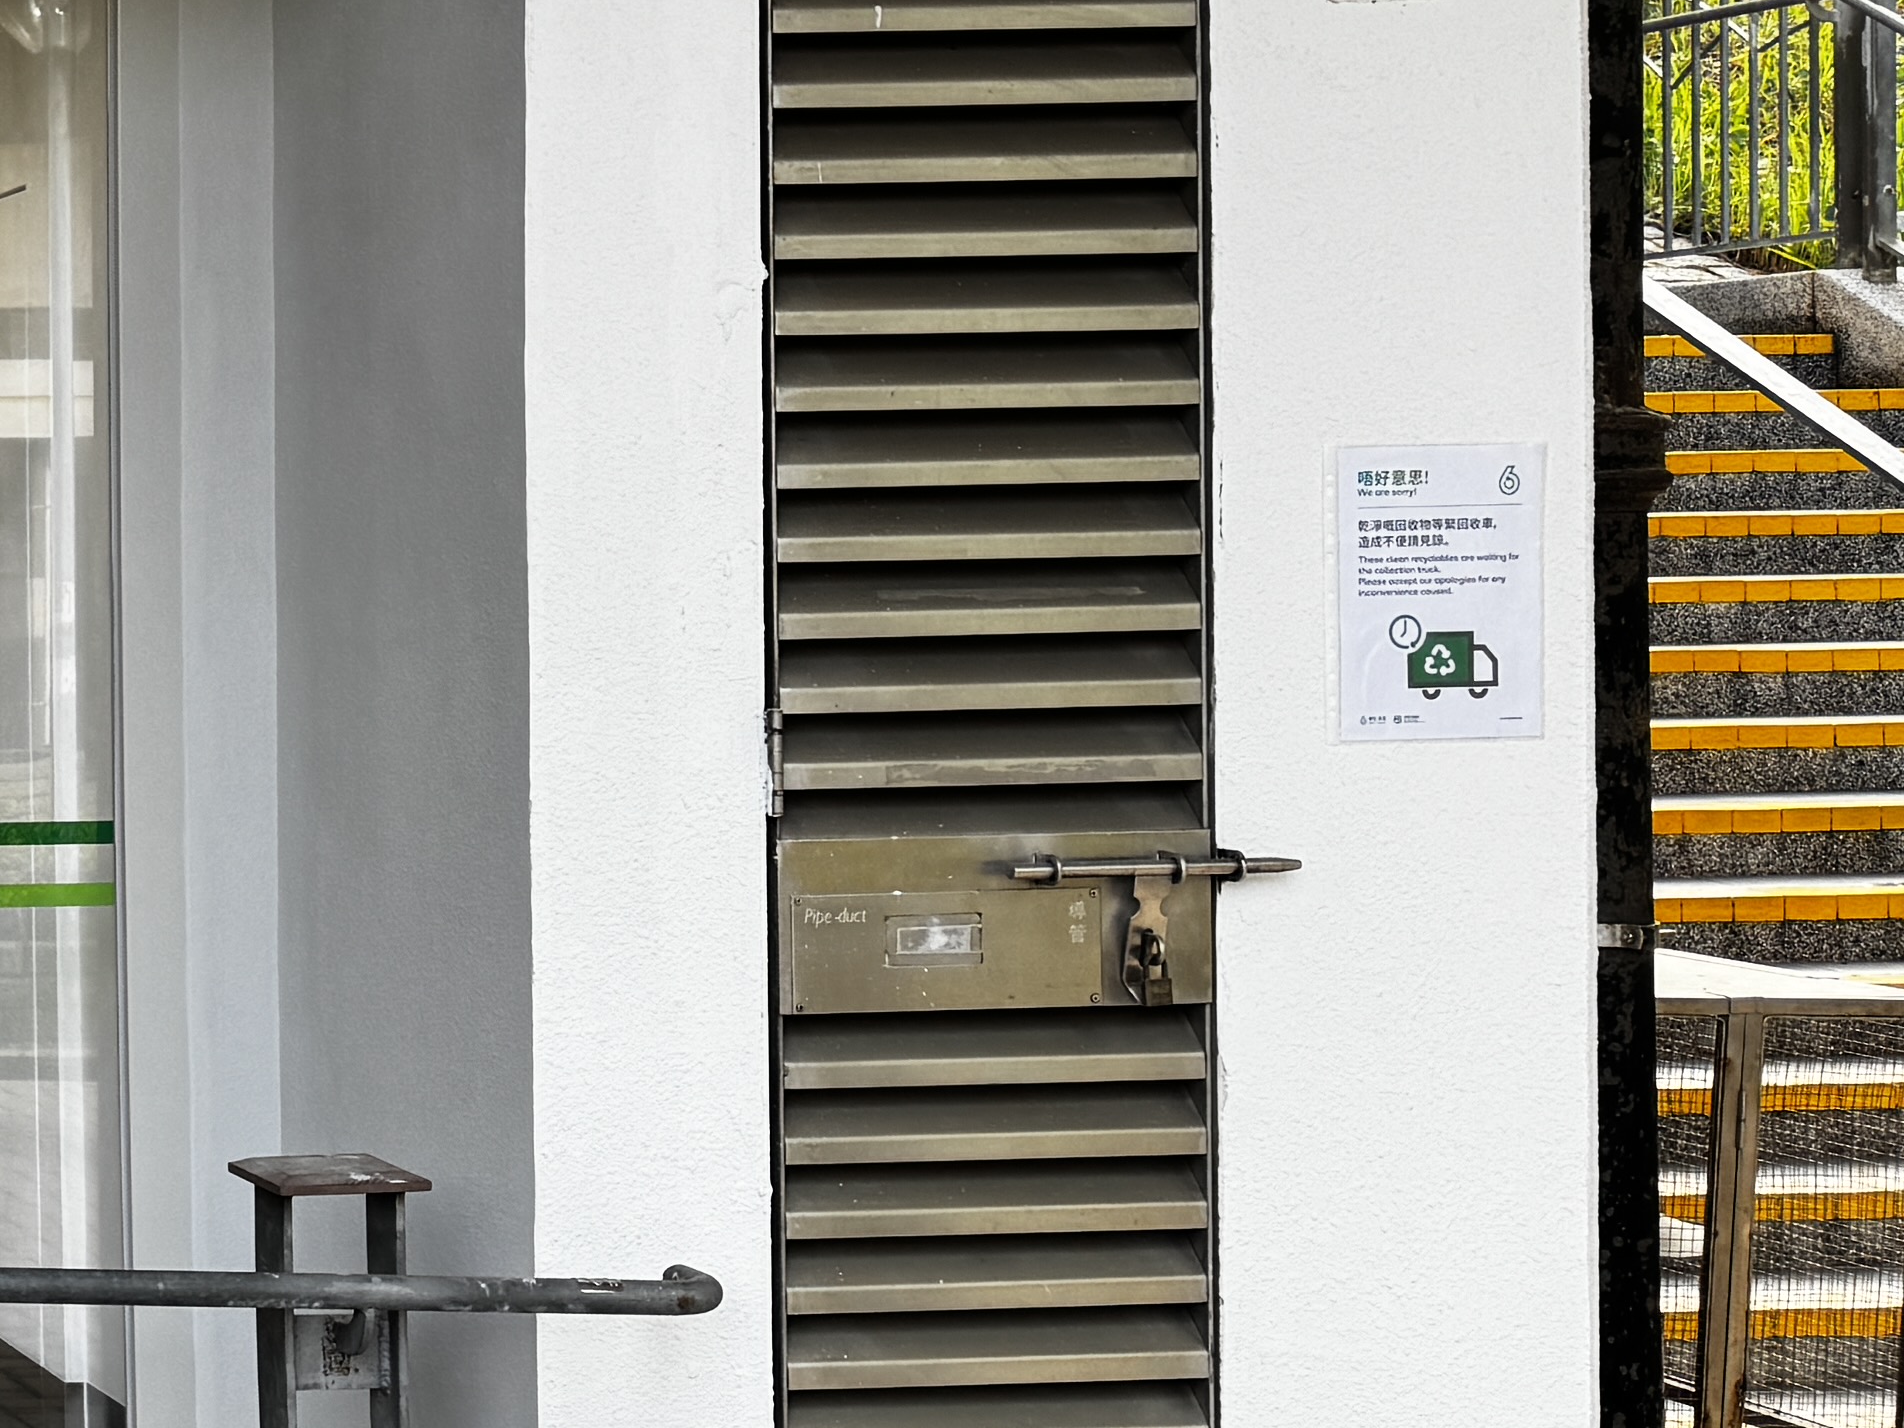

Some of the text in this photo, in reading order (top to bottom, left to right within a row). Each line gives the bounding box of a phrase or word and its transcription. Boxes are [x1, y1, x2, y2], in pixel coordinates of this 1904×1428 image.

[1357, 487, 1417, 498] We are sorry!
